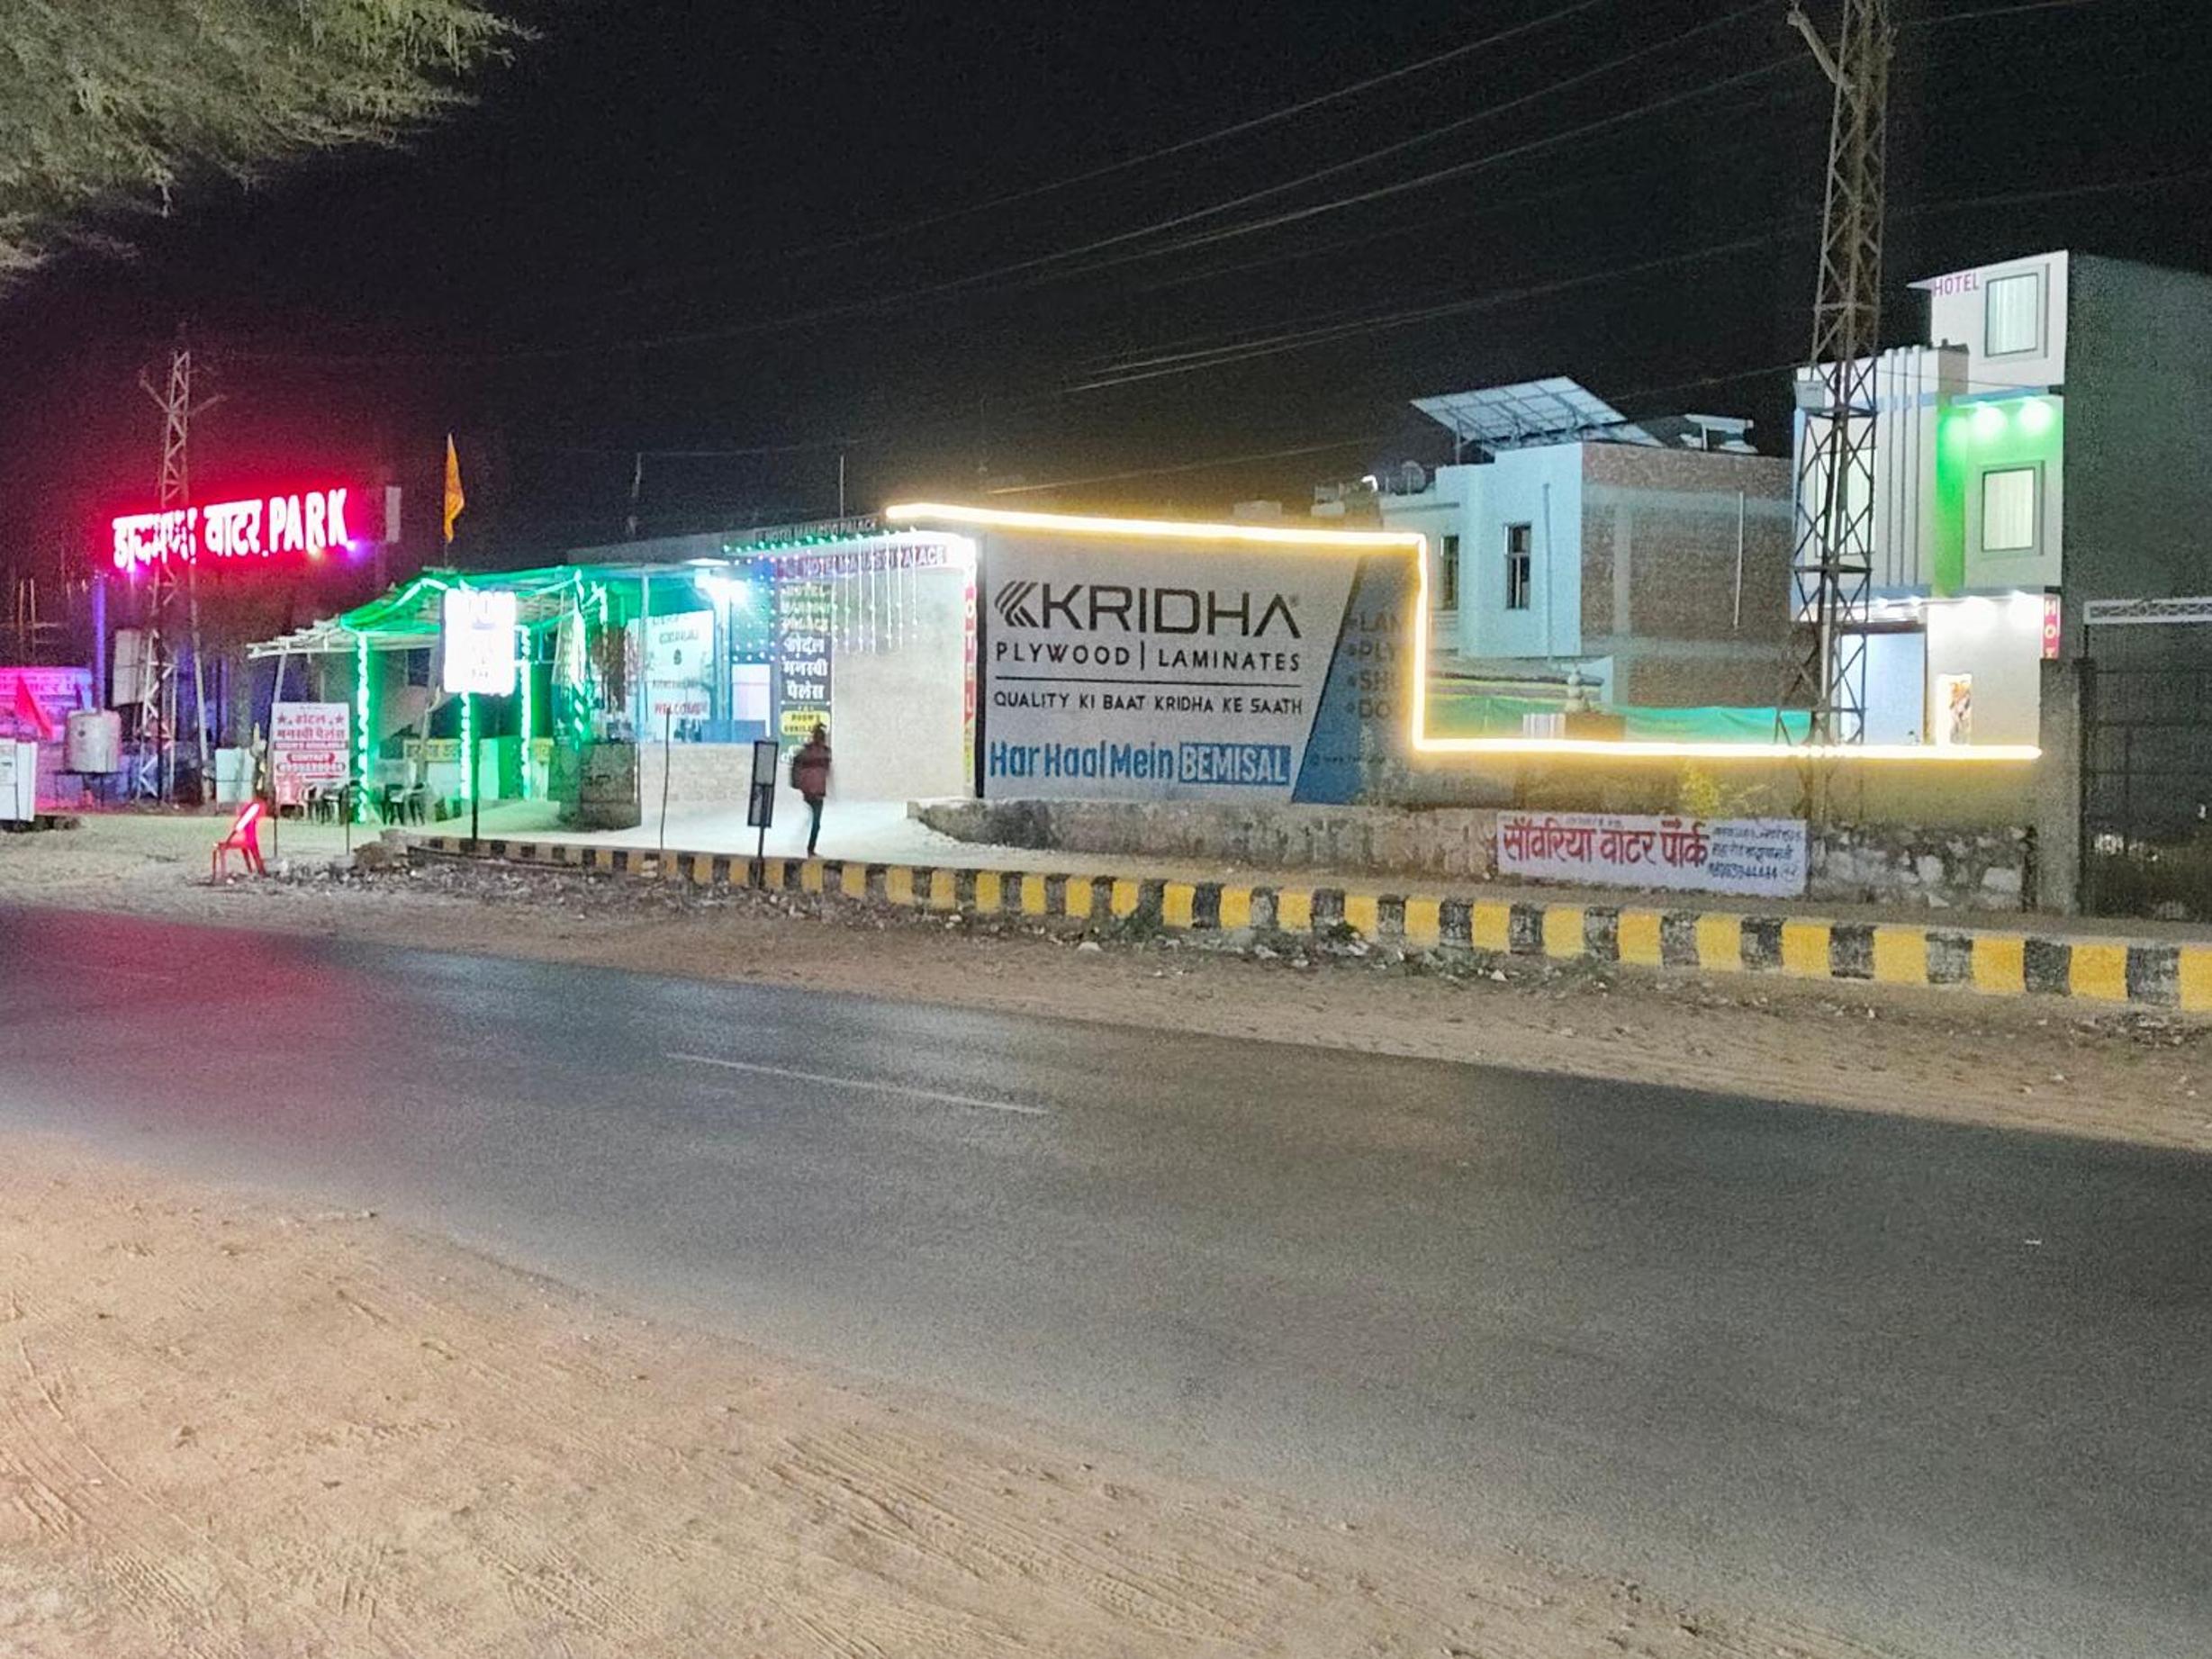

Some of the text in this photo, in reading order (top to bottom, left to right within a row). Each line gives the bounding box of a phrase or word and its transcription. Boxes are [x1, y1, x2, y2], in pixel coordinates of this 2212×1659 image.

[1935, 274, 1980, 295] HOTEL
[269, 488, 348, 554] PARK
[1042, 582, 1302, 639] KRIDHA
[996, 642, 1301, 672] PLYWOOD LAMINATES
[994, 690, 1304, 716] QUALITY KI BAAT KRIDHA KE SAATH
[989, 739, 1039, 779] Har
[1044, 740, 1106, 779] Haal
[1110, 741, 1175, 780] Mein
[1180, 745, 1290, 783] BEMISAL
[1600, 828, 1657, 865] वाटर
